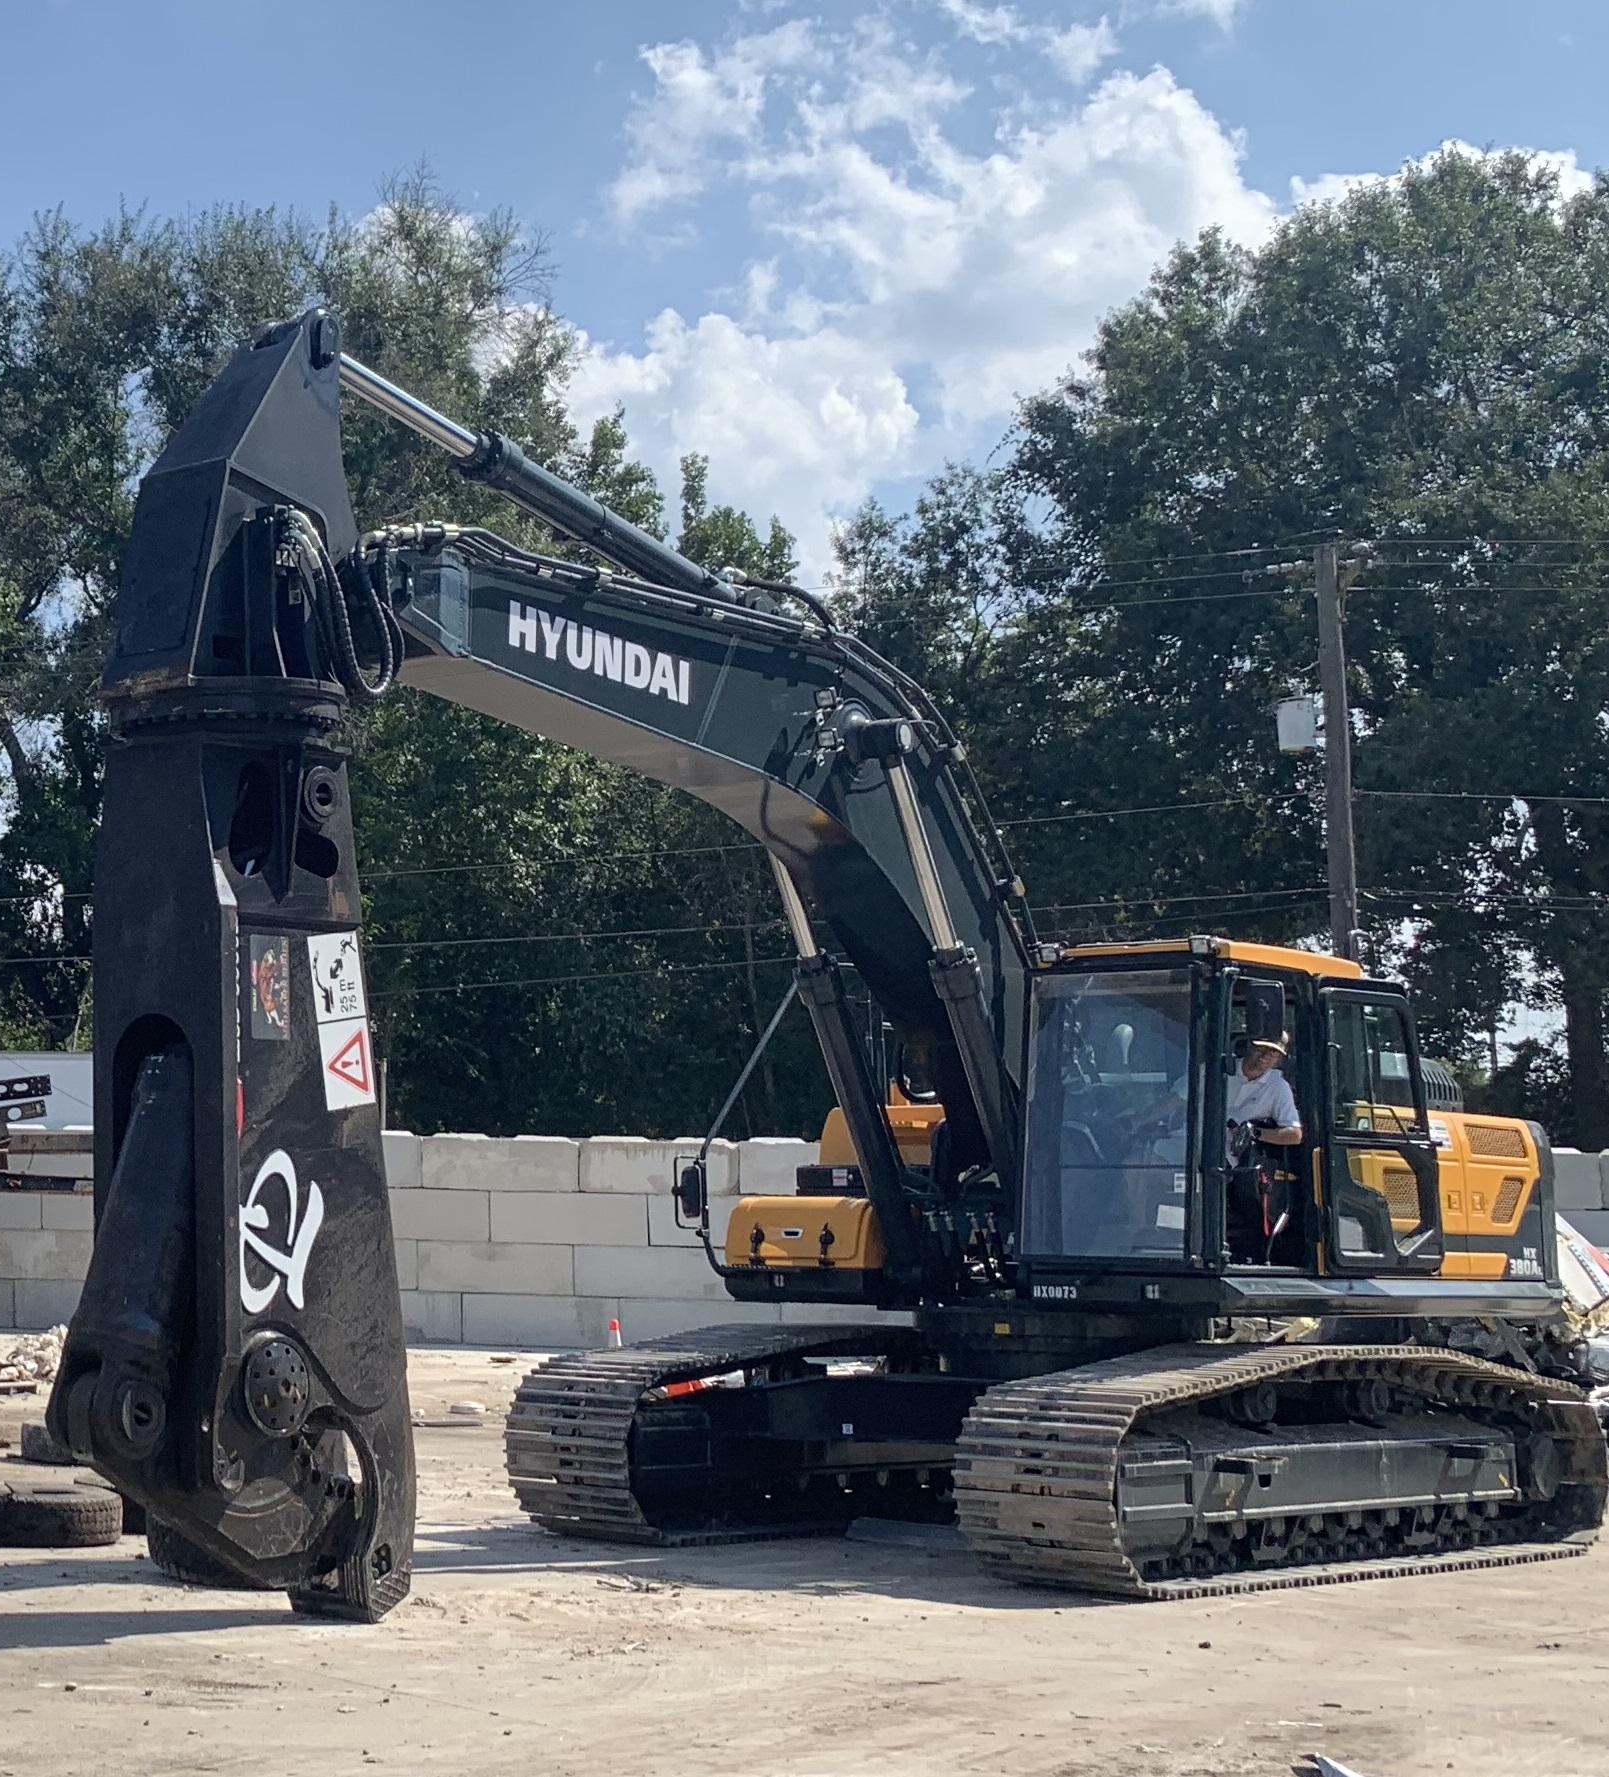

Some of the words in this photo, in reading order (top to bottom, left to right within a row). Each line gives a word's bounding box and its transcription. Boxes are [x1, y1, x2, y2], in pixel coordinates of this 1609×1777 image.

[509, 600, 690, 706] HYUNDAI
[339, 979, 347, 991] m
[347, 981, 355, 991] ft
[340, 996, 349, 1013] 25
[348, 995, 358, 1012] 75
[1523, 1247, 1537, 1259] HX
